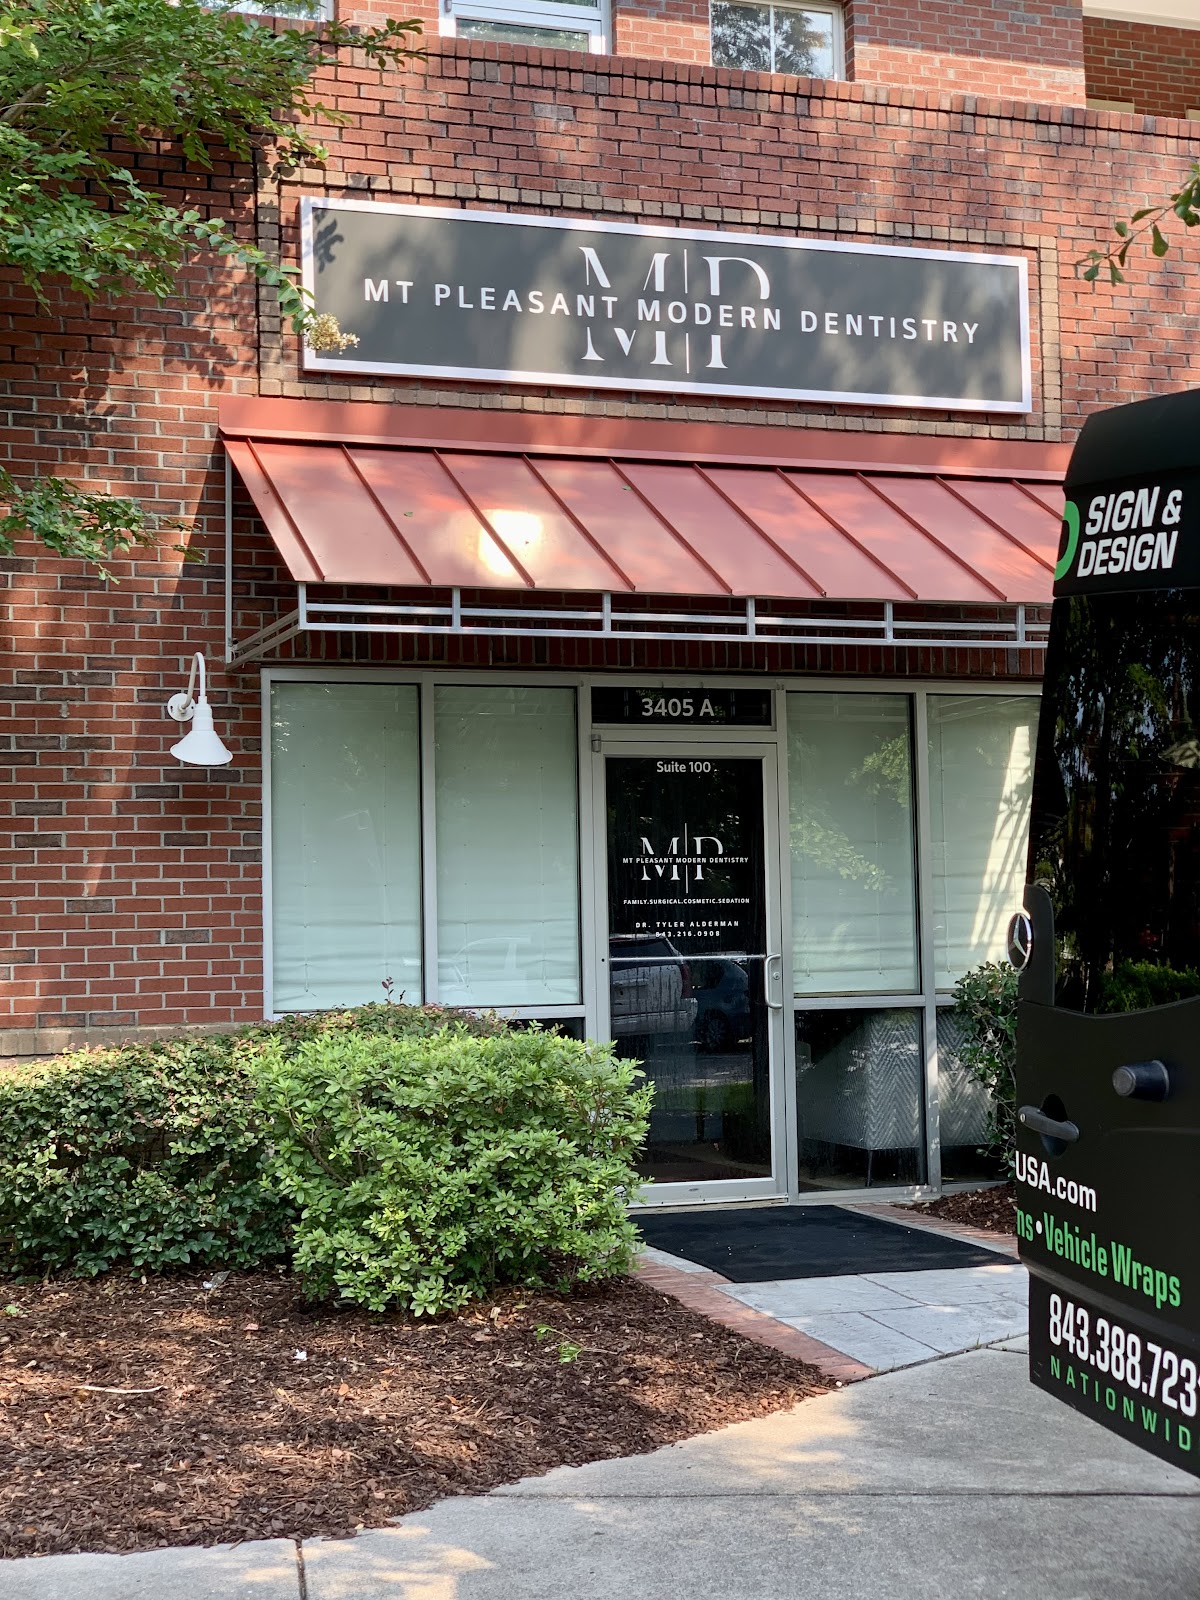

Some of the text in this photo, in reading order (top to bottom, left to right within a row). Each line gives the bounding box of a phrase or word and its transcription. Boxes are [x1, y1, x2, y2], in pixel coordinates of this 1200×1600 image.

[364, 278, 980, 344] MT PLEASANT MODERN DENTISTRY
[1085, 486, 1183, 536] SIGN &
[1076, 530, 1179, 578] DESIGN
[641, 697, 715, 717] 3405 A
[656, 761, 712, 773] Suite 100
[1015, 1150, 1097, 1213] USA.com
[1110, 1240, 1181, 1309] Wraps
[1049, 1293, 1200, 1418] 843.388.723
